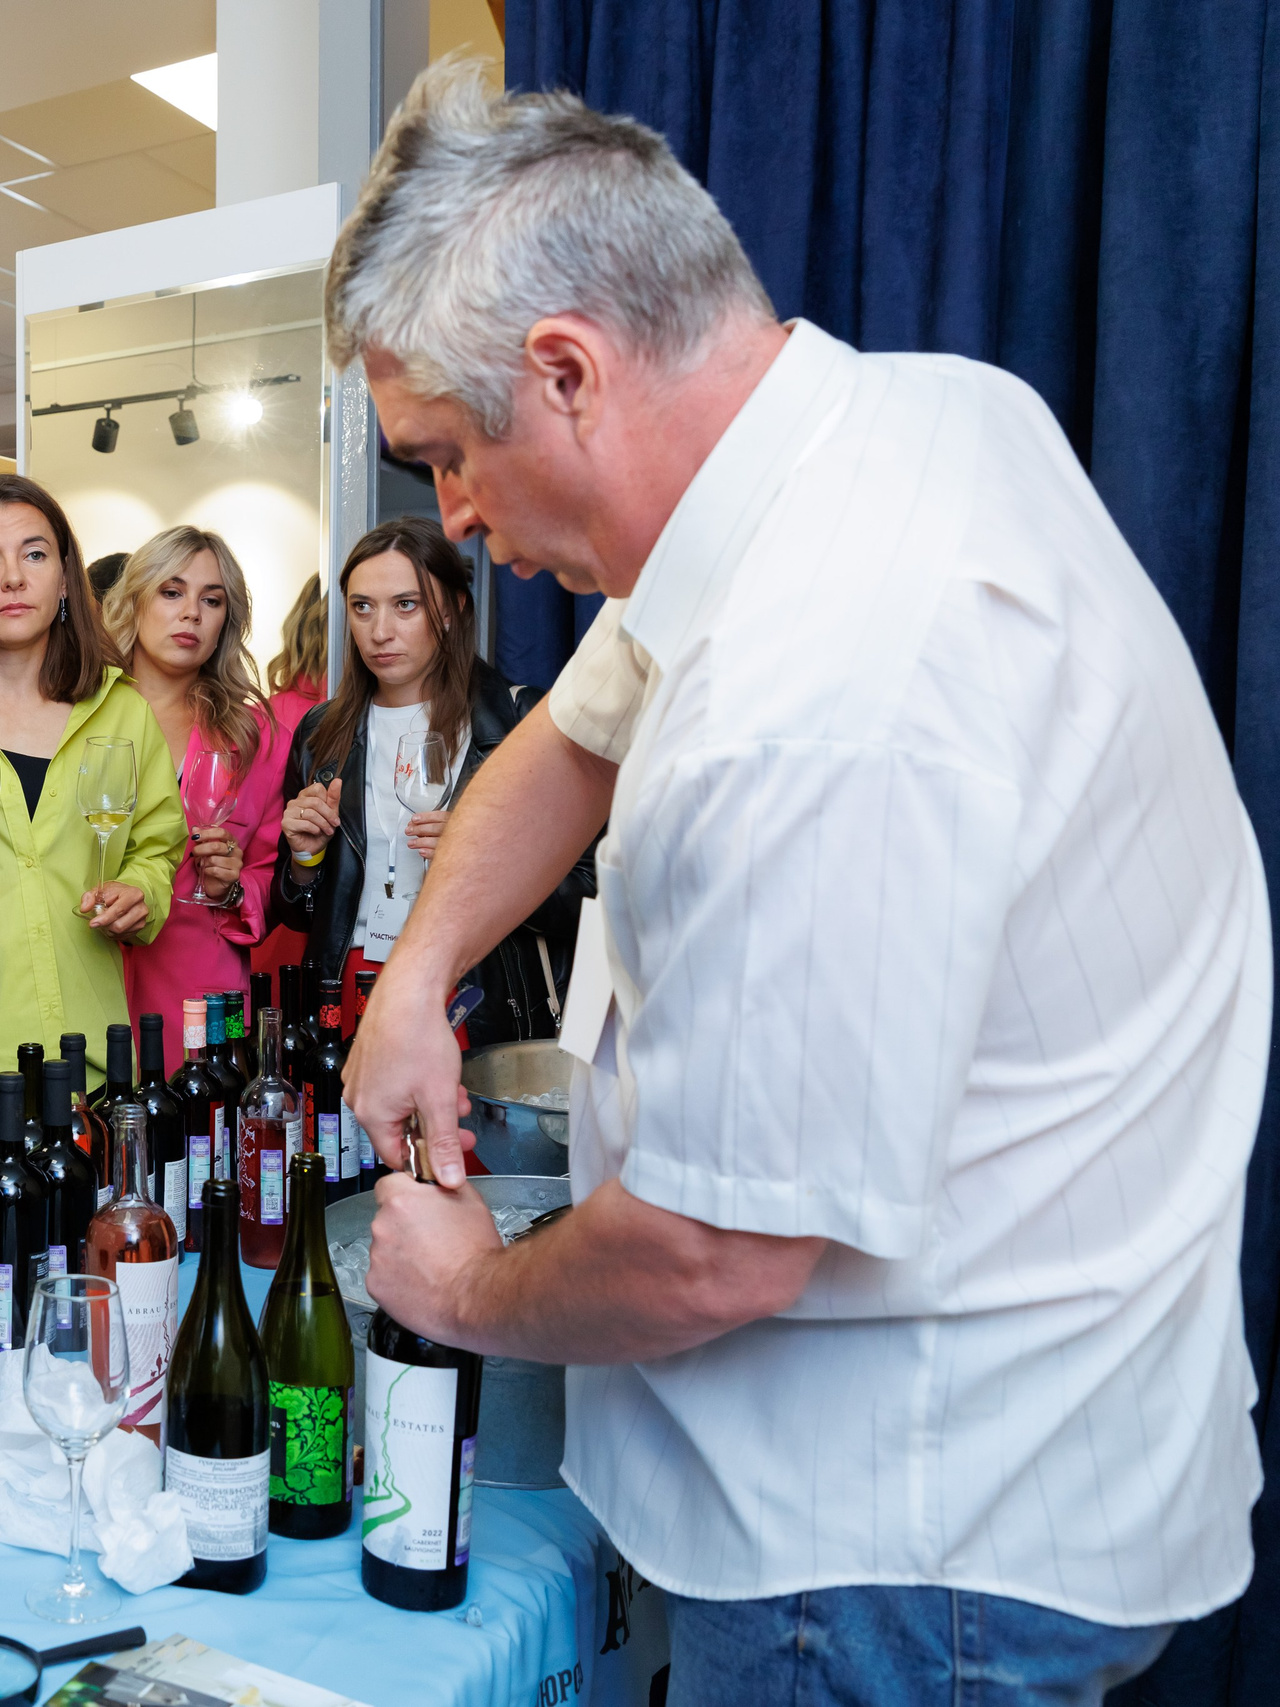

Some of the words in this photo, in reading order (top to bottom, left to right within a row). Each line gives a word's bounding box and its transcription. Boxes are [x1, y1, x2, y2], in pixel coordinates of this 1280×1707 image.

[393, 1418, 445, 1433] ESTATES
[422, 1529, 442, 1537] 2022
[404, 1545, 441, 1553] SAUVIGNON
